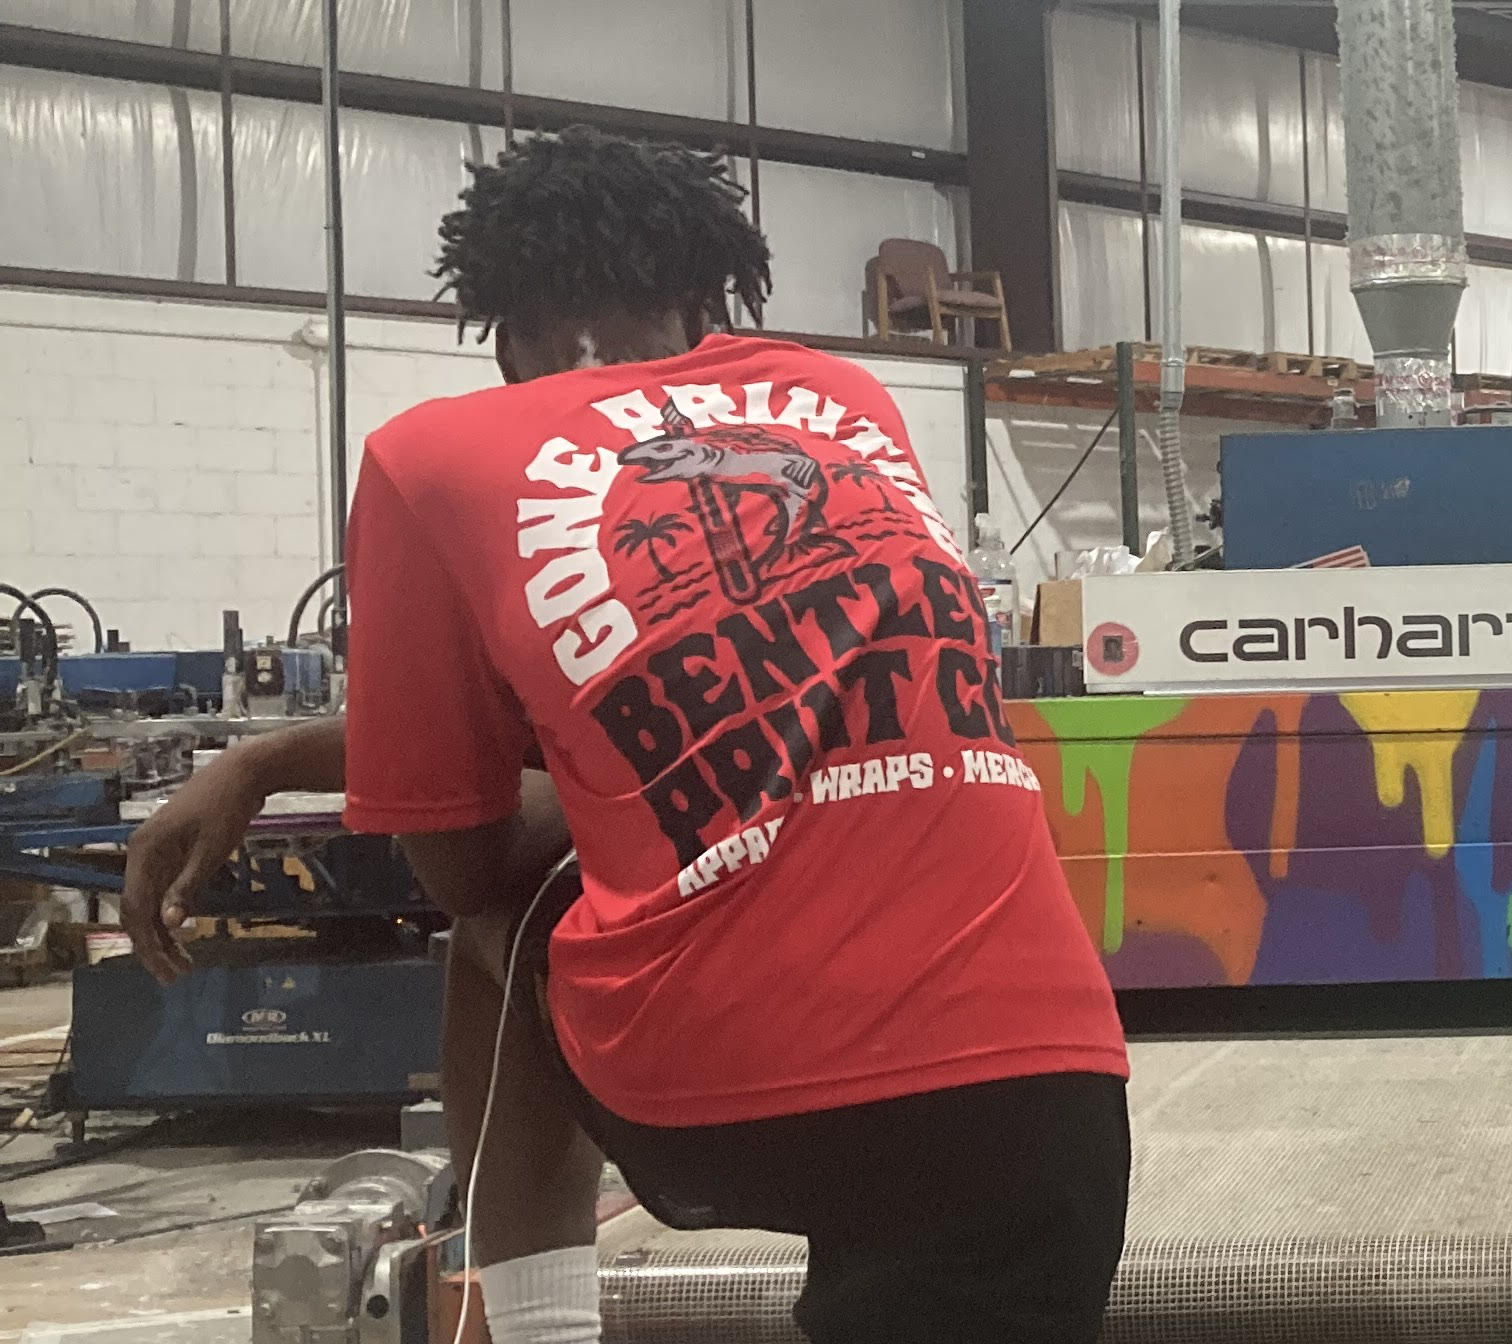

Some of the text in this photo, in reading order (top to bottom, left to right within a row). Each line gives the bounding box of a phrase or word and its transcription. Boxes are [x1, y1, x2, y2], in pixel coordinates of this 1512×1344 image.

[516, 436, 638, 687] GONE
[809, 752, 934, 806] WRAPS
[311, 1031, 331, 1043] XL
